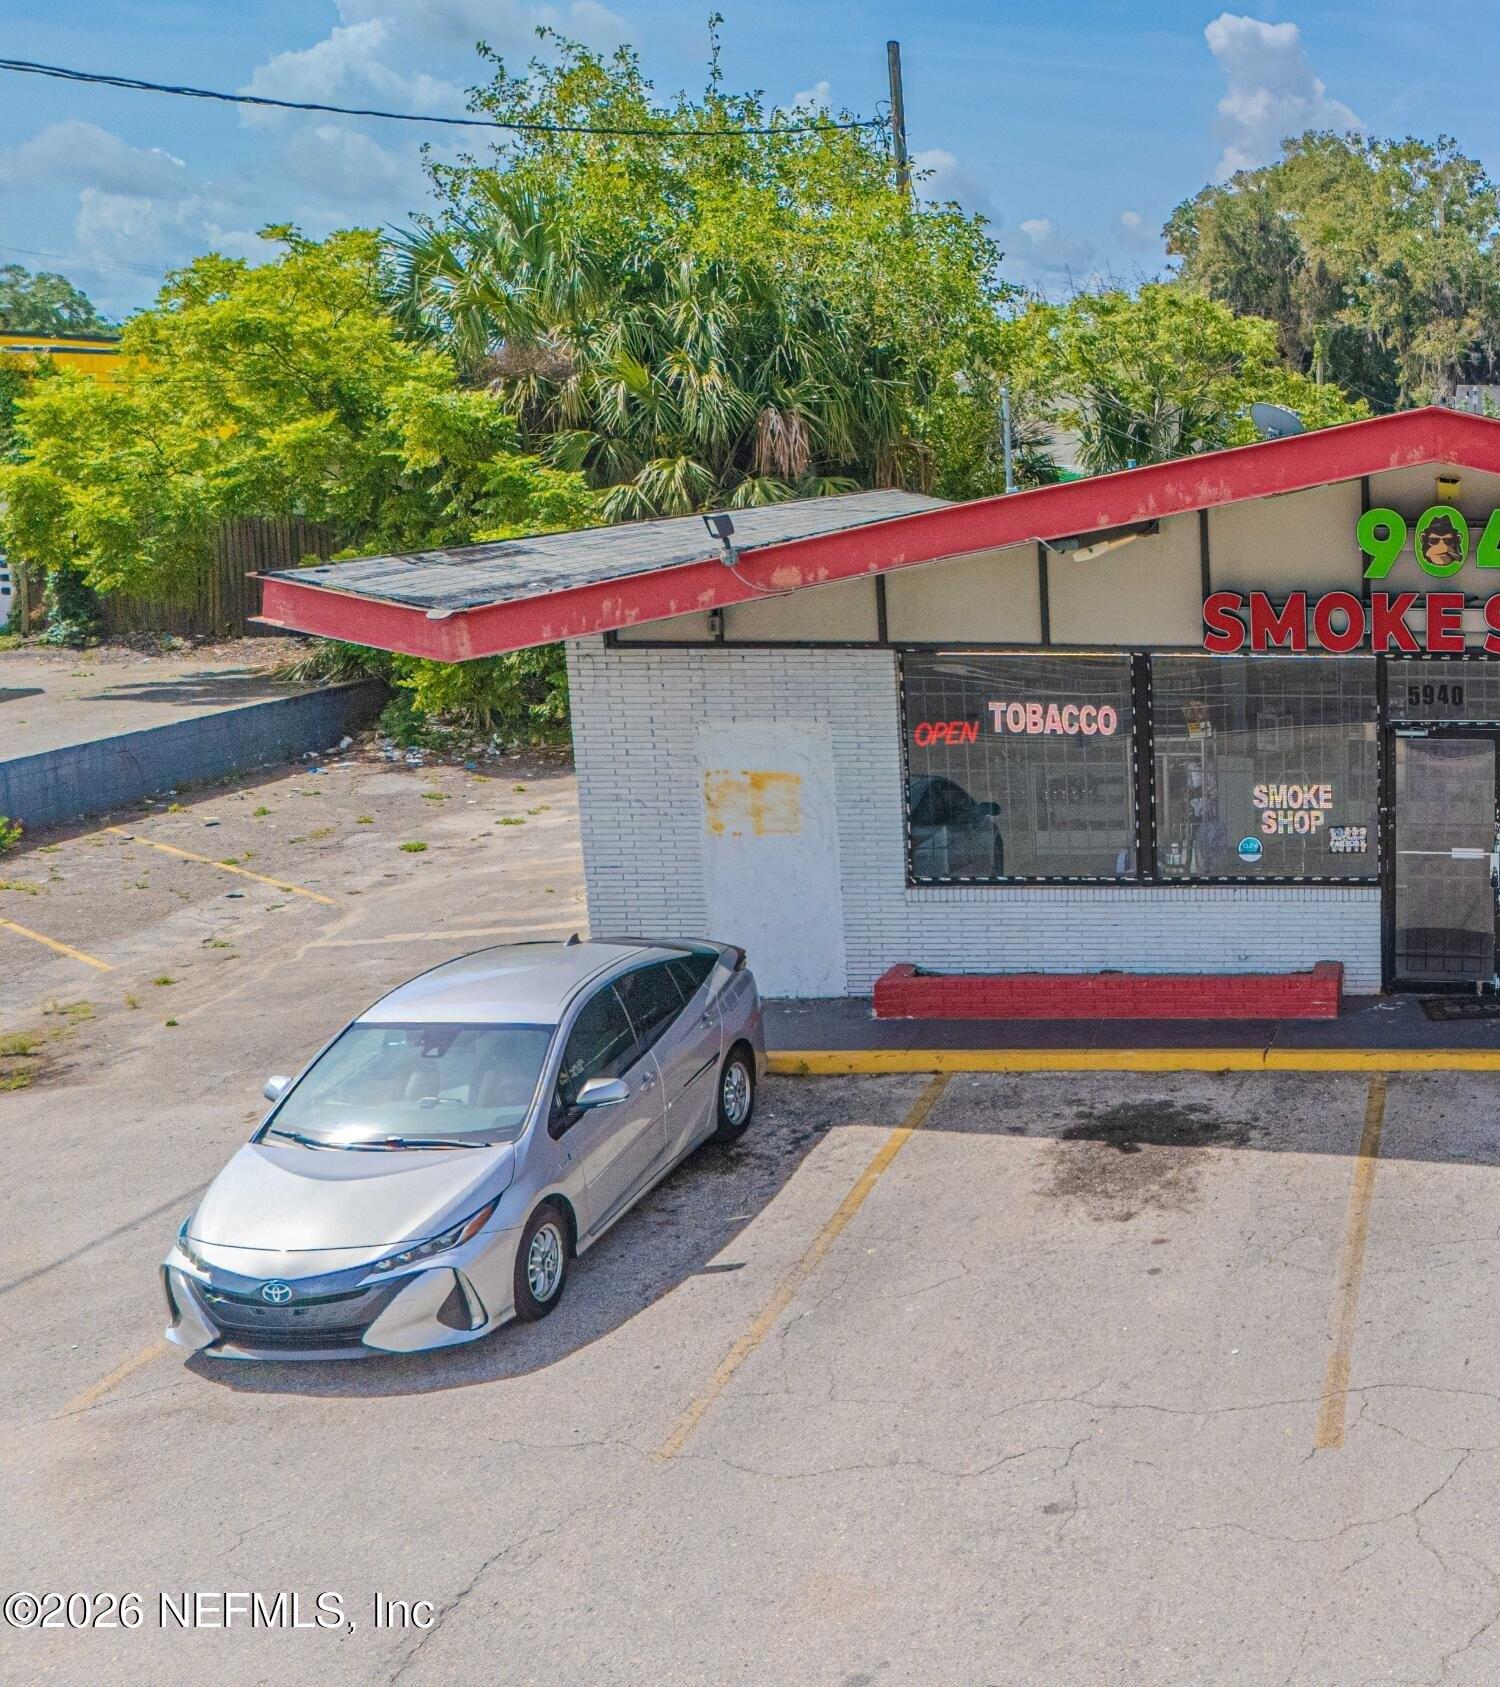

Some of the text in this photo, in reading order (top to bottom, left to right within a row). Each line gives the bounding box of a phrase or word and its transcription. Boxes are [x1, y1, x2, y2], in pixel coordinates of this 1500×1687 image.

[1202, 592, 1465, 654] SMOKE
[1407, 684, 1464, 706] 5940
[989, 702, 1117, 736] TOBACCO
[914, 721, 980, 747] OPEN
[1253, 784, 1333, 809] SMOKE
[1261, 810, 1325, 834] SHOP
